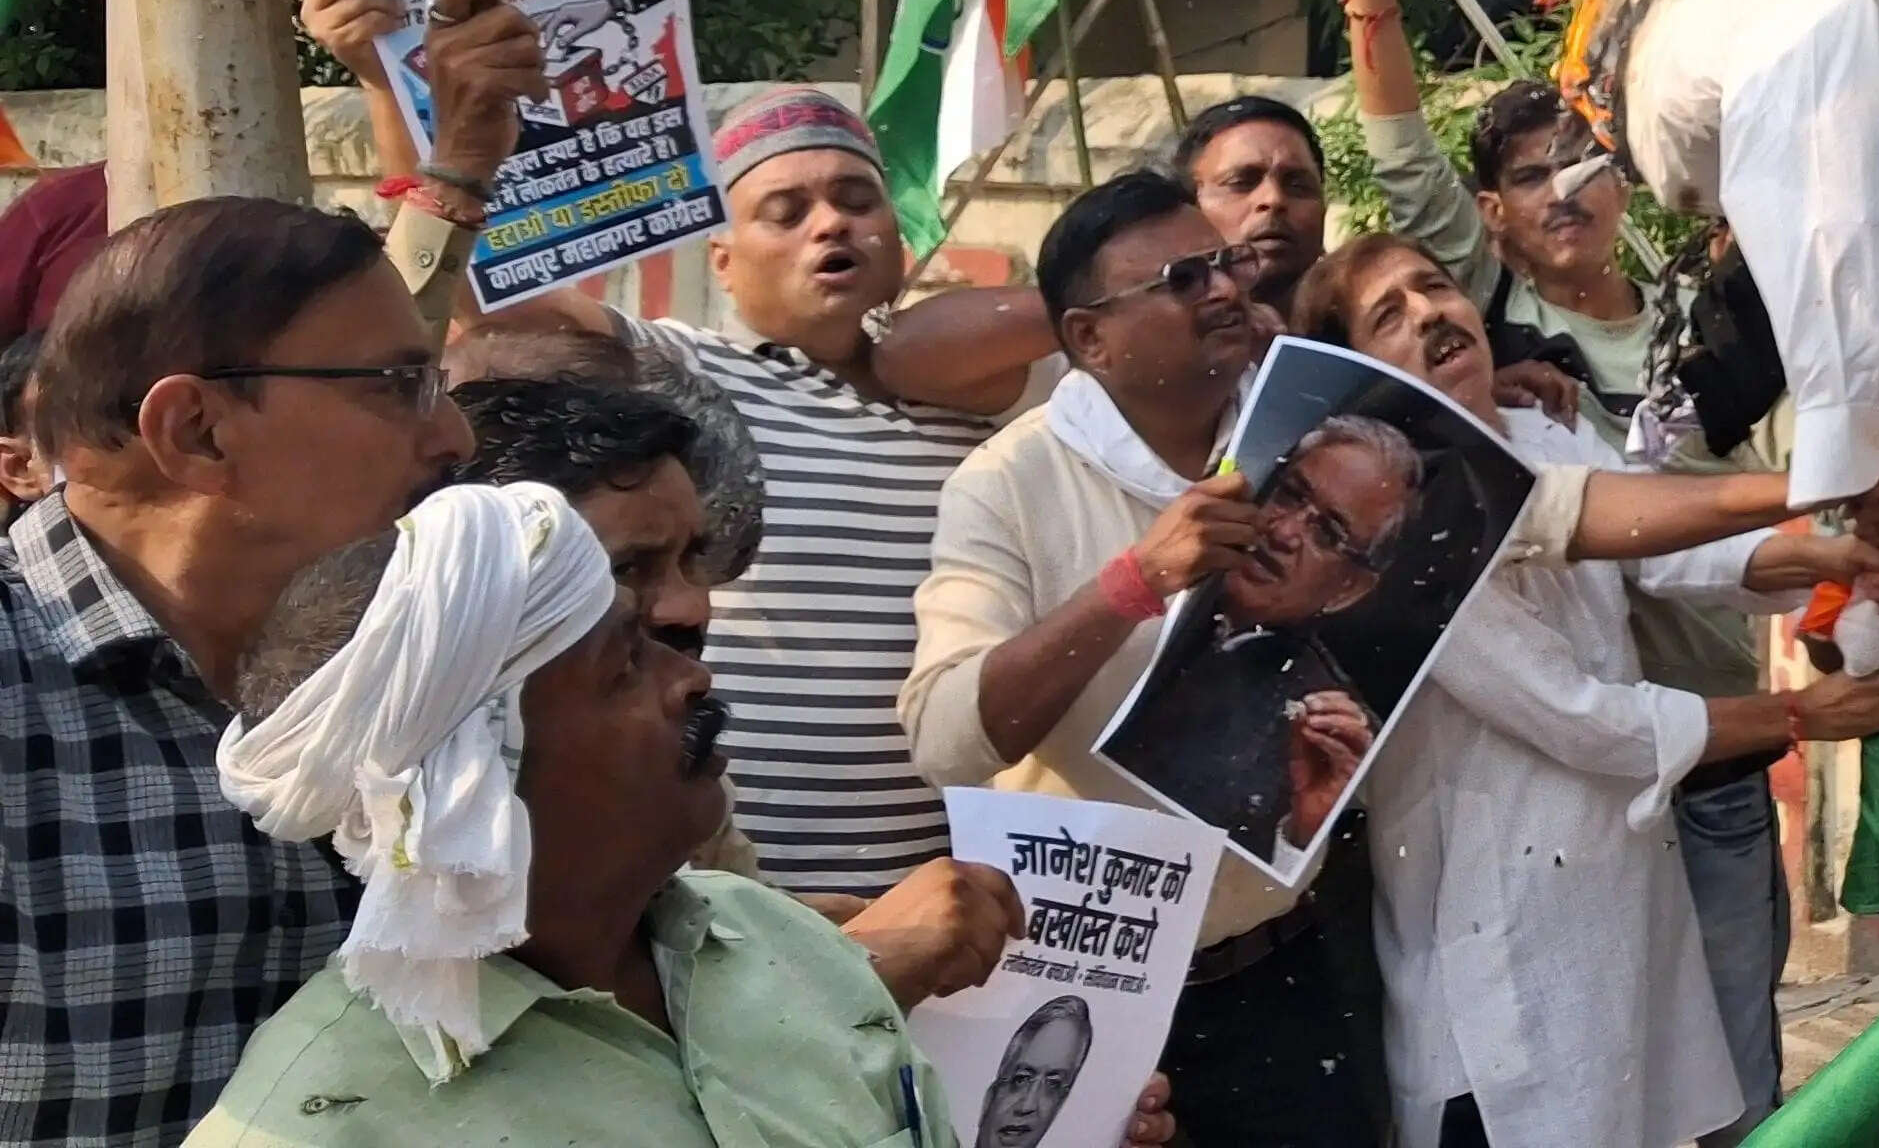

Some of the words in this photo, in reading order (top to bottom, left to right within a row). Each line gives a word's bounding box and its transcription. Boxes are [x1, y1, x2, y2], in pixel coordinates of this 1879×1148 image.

[485, 250, 560, 291] कानपुर
[559, 218, 645, 264] महानगर
[648, 196, 712, 236] कांग्रेस
[1006, 826, 1101, 885] ज्ञानेश
[1098, 848, 1165, 905] कुमार
[1161, 852, 1192, 904] को
[1028, 893, 1116, 957] बर्खास्त
[1114, 906, 1159, 964] करो
